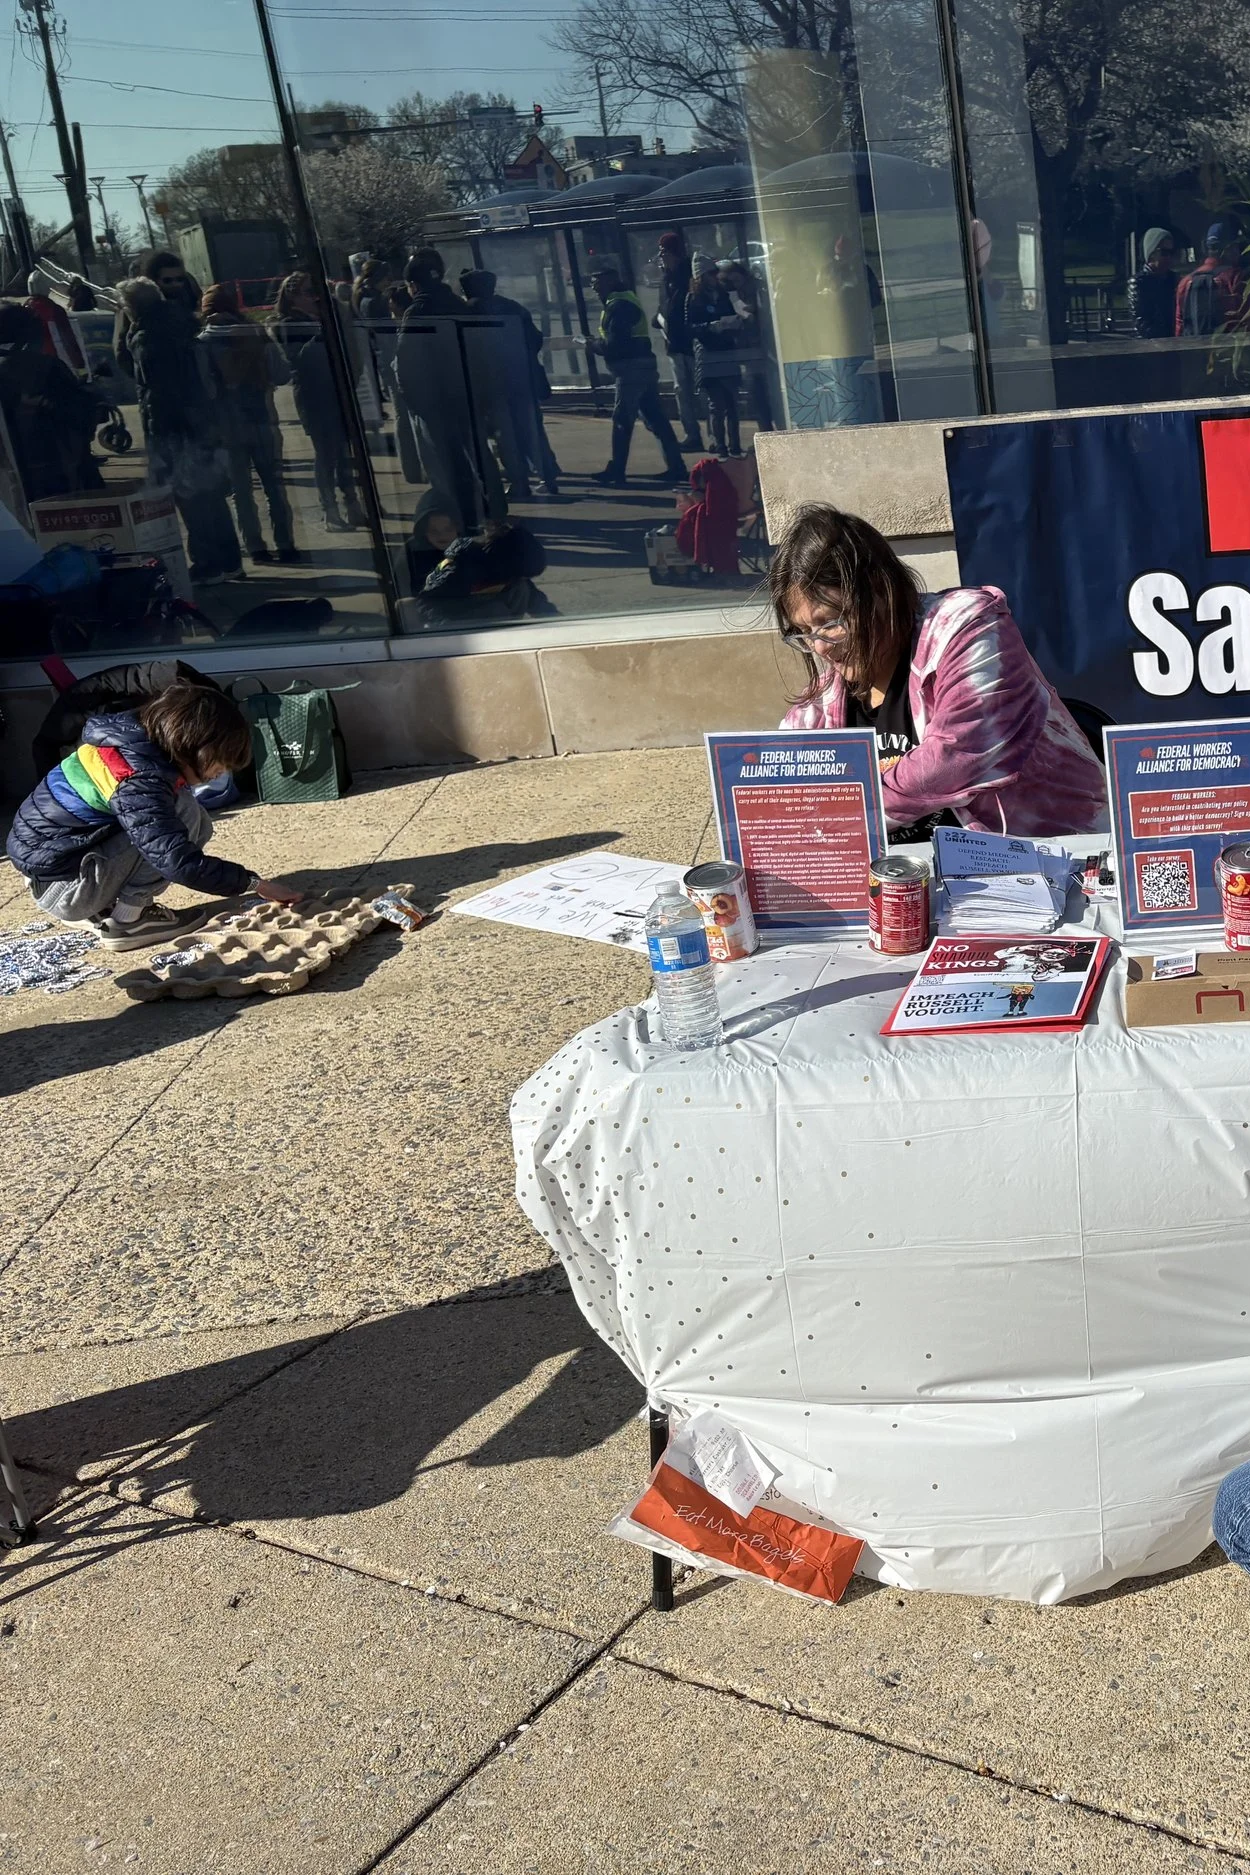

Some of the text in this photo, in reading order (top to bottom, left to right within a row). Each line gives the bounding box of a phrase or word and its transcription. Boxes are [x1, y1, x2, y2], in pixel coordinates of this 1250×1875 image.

[760, 749, 837, 764] FEDERAL WORKERS
[1156, 741, 1233, 760] FEDERAL WORKERS
[740, 762, 848, 778] ALLIANCE FOR DEMOCRACY
[1135, 754, 1242, 775] ALLIANCE FOR DEMOCRACY
[1171, 792, 1191, 801] FEDERAL
[1150, 805, 1159, 814] you
[1159, 803, 1185, 812] interested
[1191, 801, 1221, 811] contributing
[1221, 801, 1233, 810] your
[1233, 800, 1248, 808] policy
[1139, 816, 1166, 825] experience
[1169, 824, 1181, 832] with
[1181, 823, 1191, 831] this
[1191, 823, 1205, 832] quick
[558, 908, 598, 928] We
[935, 944, 970, 952] NO
[925, 960, 1000, 971] KINGS
[909, 991, 995, 1002] IMPEACH
[906, 999, 985, 1010] RUSSELL
[903, 1005, 985, 1018] VOUGHT.
[672, 1504, 806, 1565] Eat More Bagels
